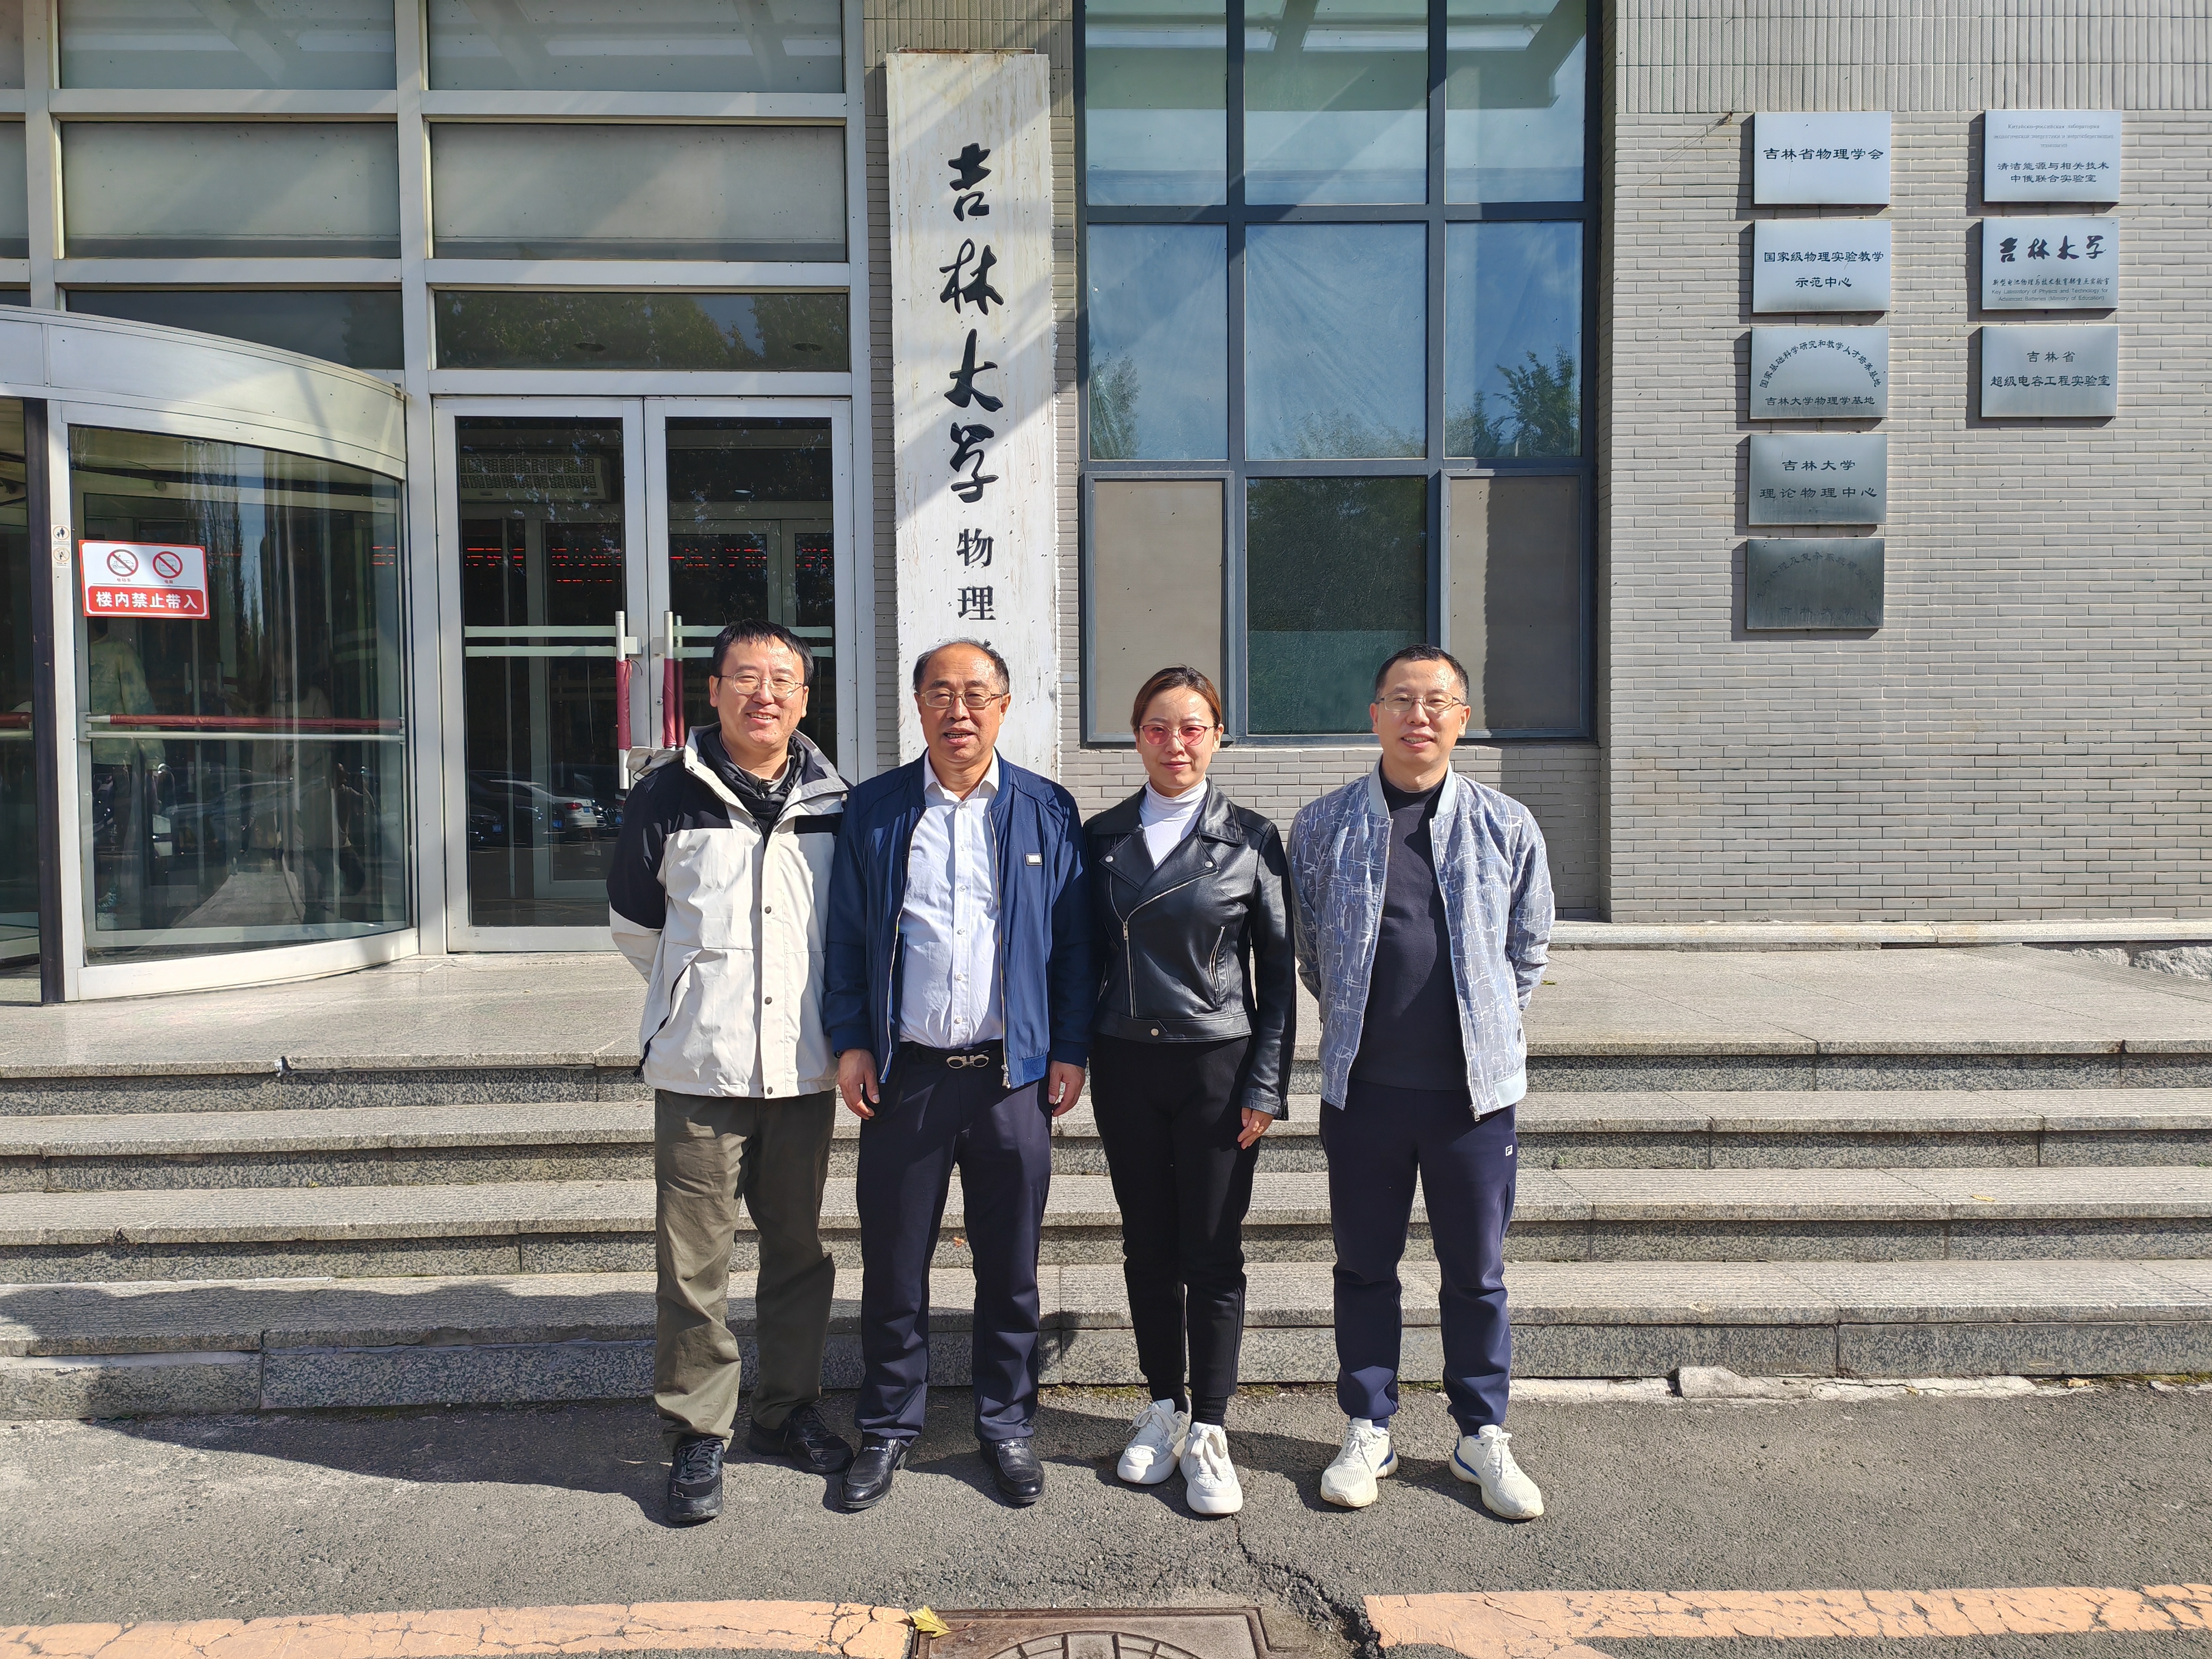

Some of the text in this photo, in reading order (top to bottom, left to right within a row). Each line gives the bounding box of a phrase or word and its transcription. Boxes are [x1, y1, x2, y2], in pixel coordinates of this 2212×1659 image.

[1763, 147, 1884, 160] 吉林省物理学会
[1997, 161, 2109, 171] 清洁能源与相关技术
[2011, 174, 2097, 183] 中俄联合实验室
[1999, 235, 2107, 263] 吉林大学
[1764, 251, 1884, 262] 国家级物理实验教学
[1795, 276, 1852, 288] 示范中心
[2026, 350, 2076, 363] 吉林省
[1759, 339, 1882, 389] 国家基础科学研究和教学人才培养基地
[1990, 375, 2111, 388] 超级电容工程实验室
[1765, 396, 1876, 406] 吉林大学物理学基地
[1782, 459, 1856, 472] 吉林大学
[1759, 487, 1878, 499] 理论物理中心
[96, 591, 198, 610] 楼内禁止带入
